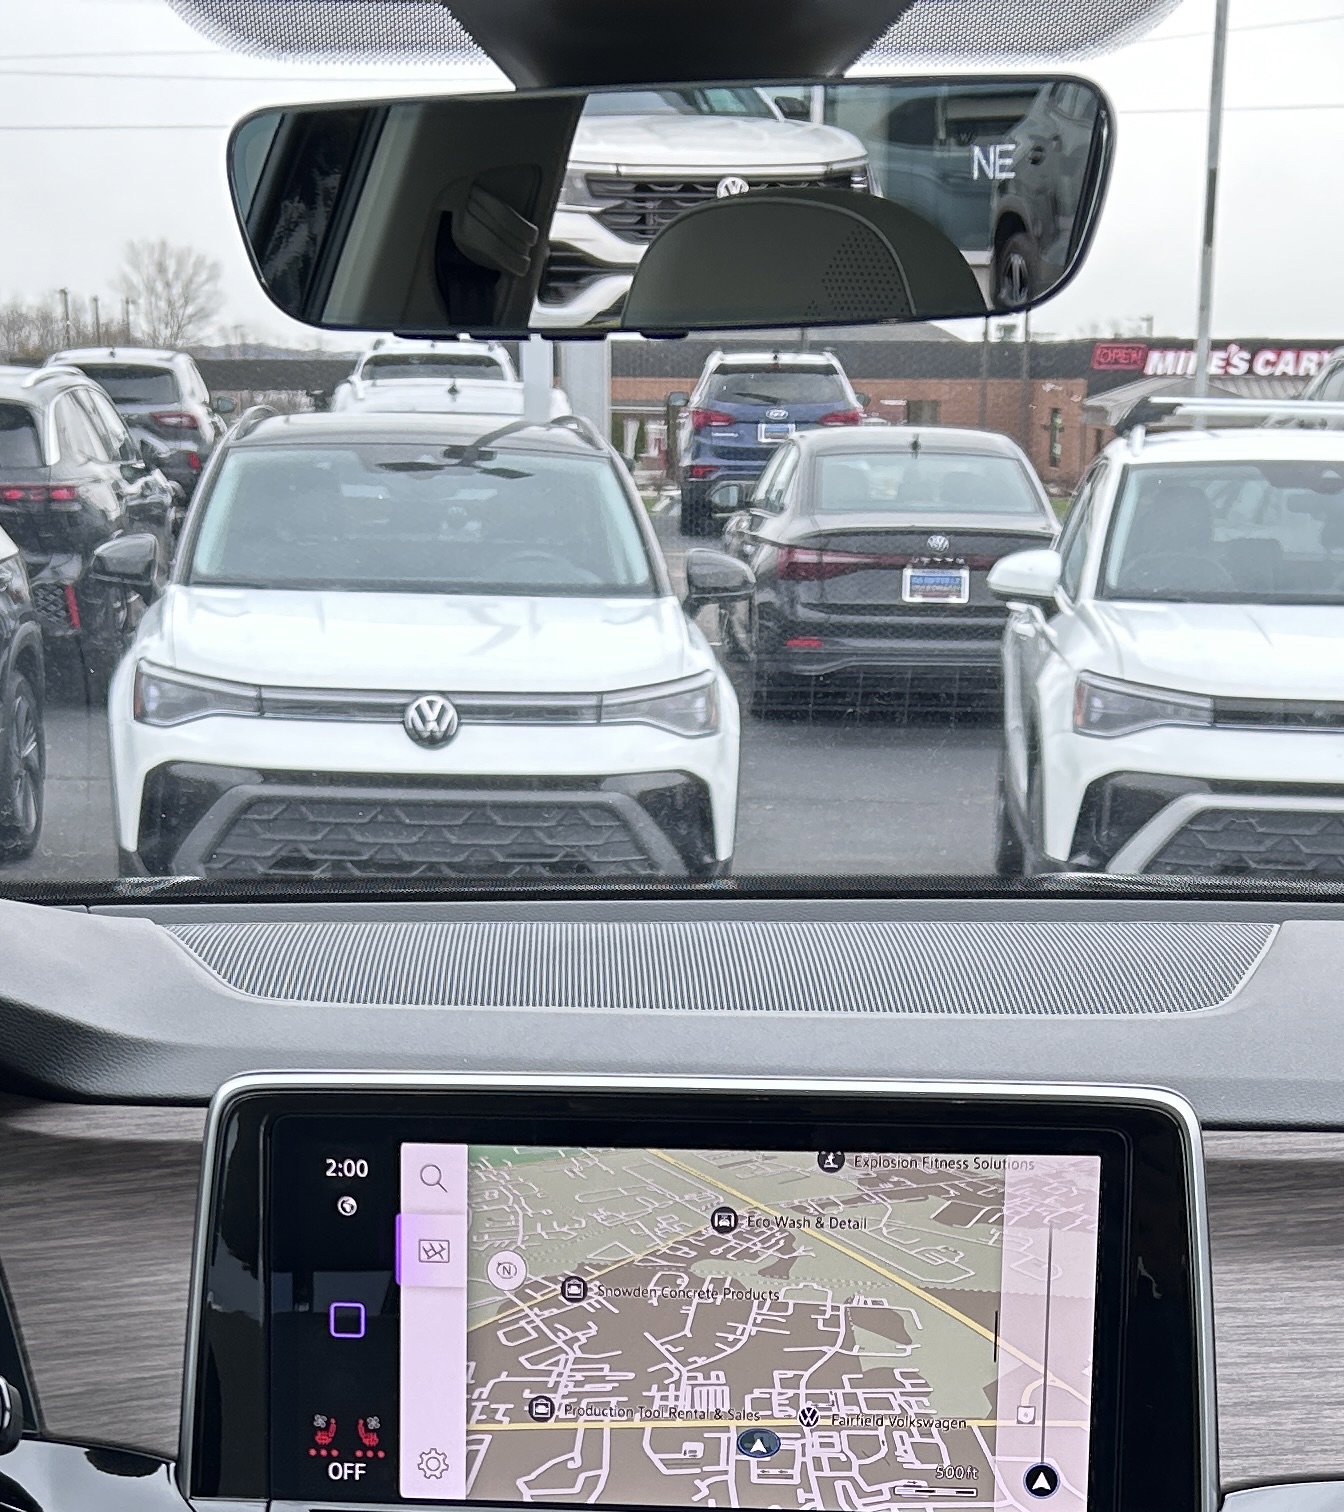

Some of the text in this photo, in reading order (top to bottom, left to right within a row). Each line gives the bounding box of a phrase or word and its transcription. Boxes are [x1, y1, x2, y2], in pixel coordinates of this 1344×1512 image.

[972, 143, 1016, 180] NE
[1099, 349, 1144, 365] OPEN
[325, 1158, 369, 1178] 2:00
[854, 1155, 1035, 1171] Explosion Fitness Solutions
[747, 1215, 867, 1230] Eco Wash & Detail
[502, 1265, 511, 1275] N
[597, 1284, 780, 1301] Snowden Concrete Products
[564, 1404, 761, 1421] Production Tool Rental & Sales
[831, 1413, 967, 1431] Fairfield Volkswagen
[328, 1462, 367, 1480] OFF
